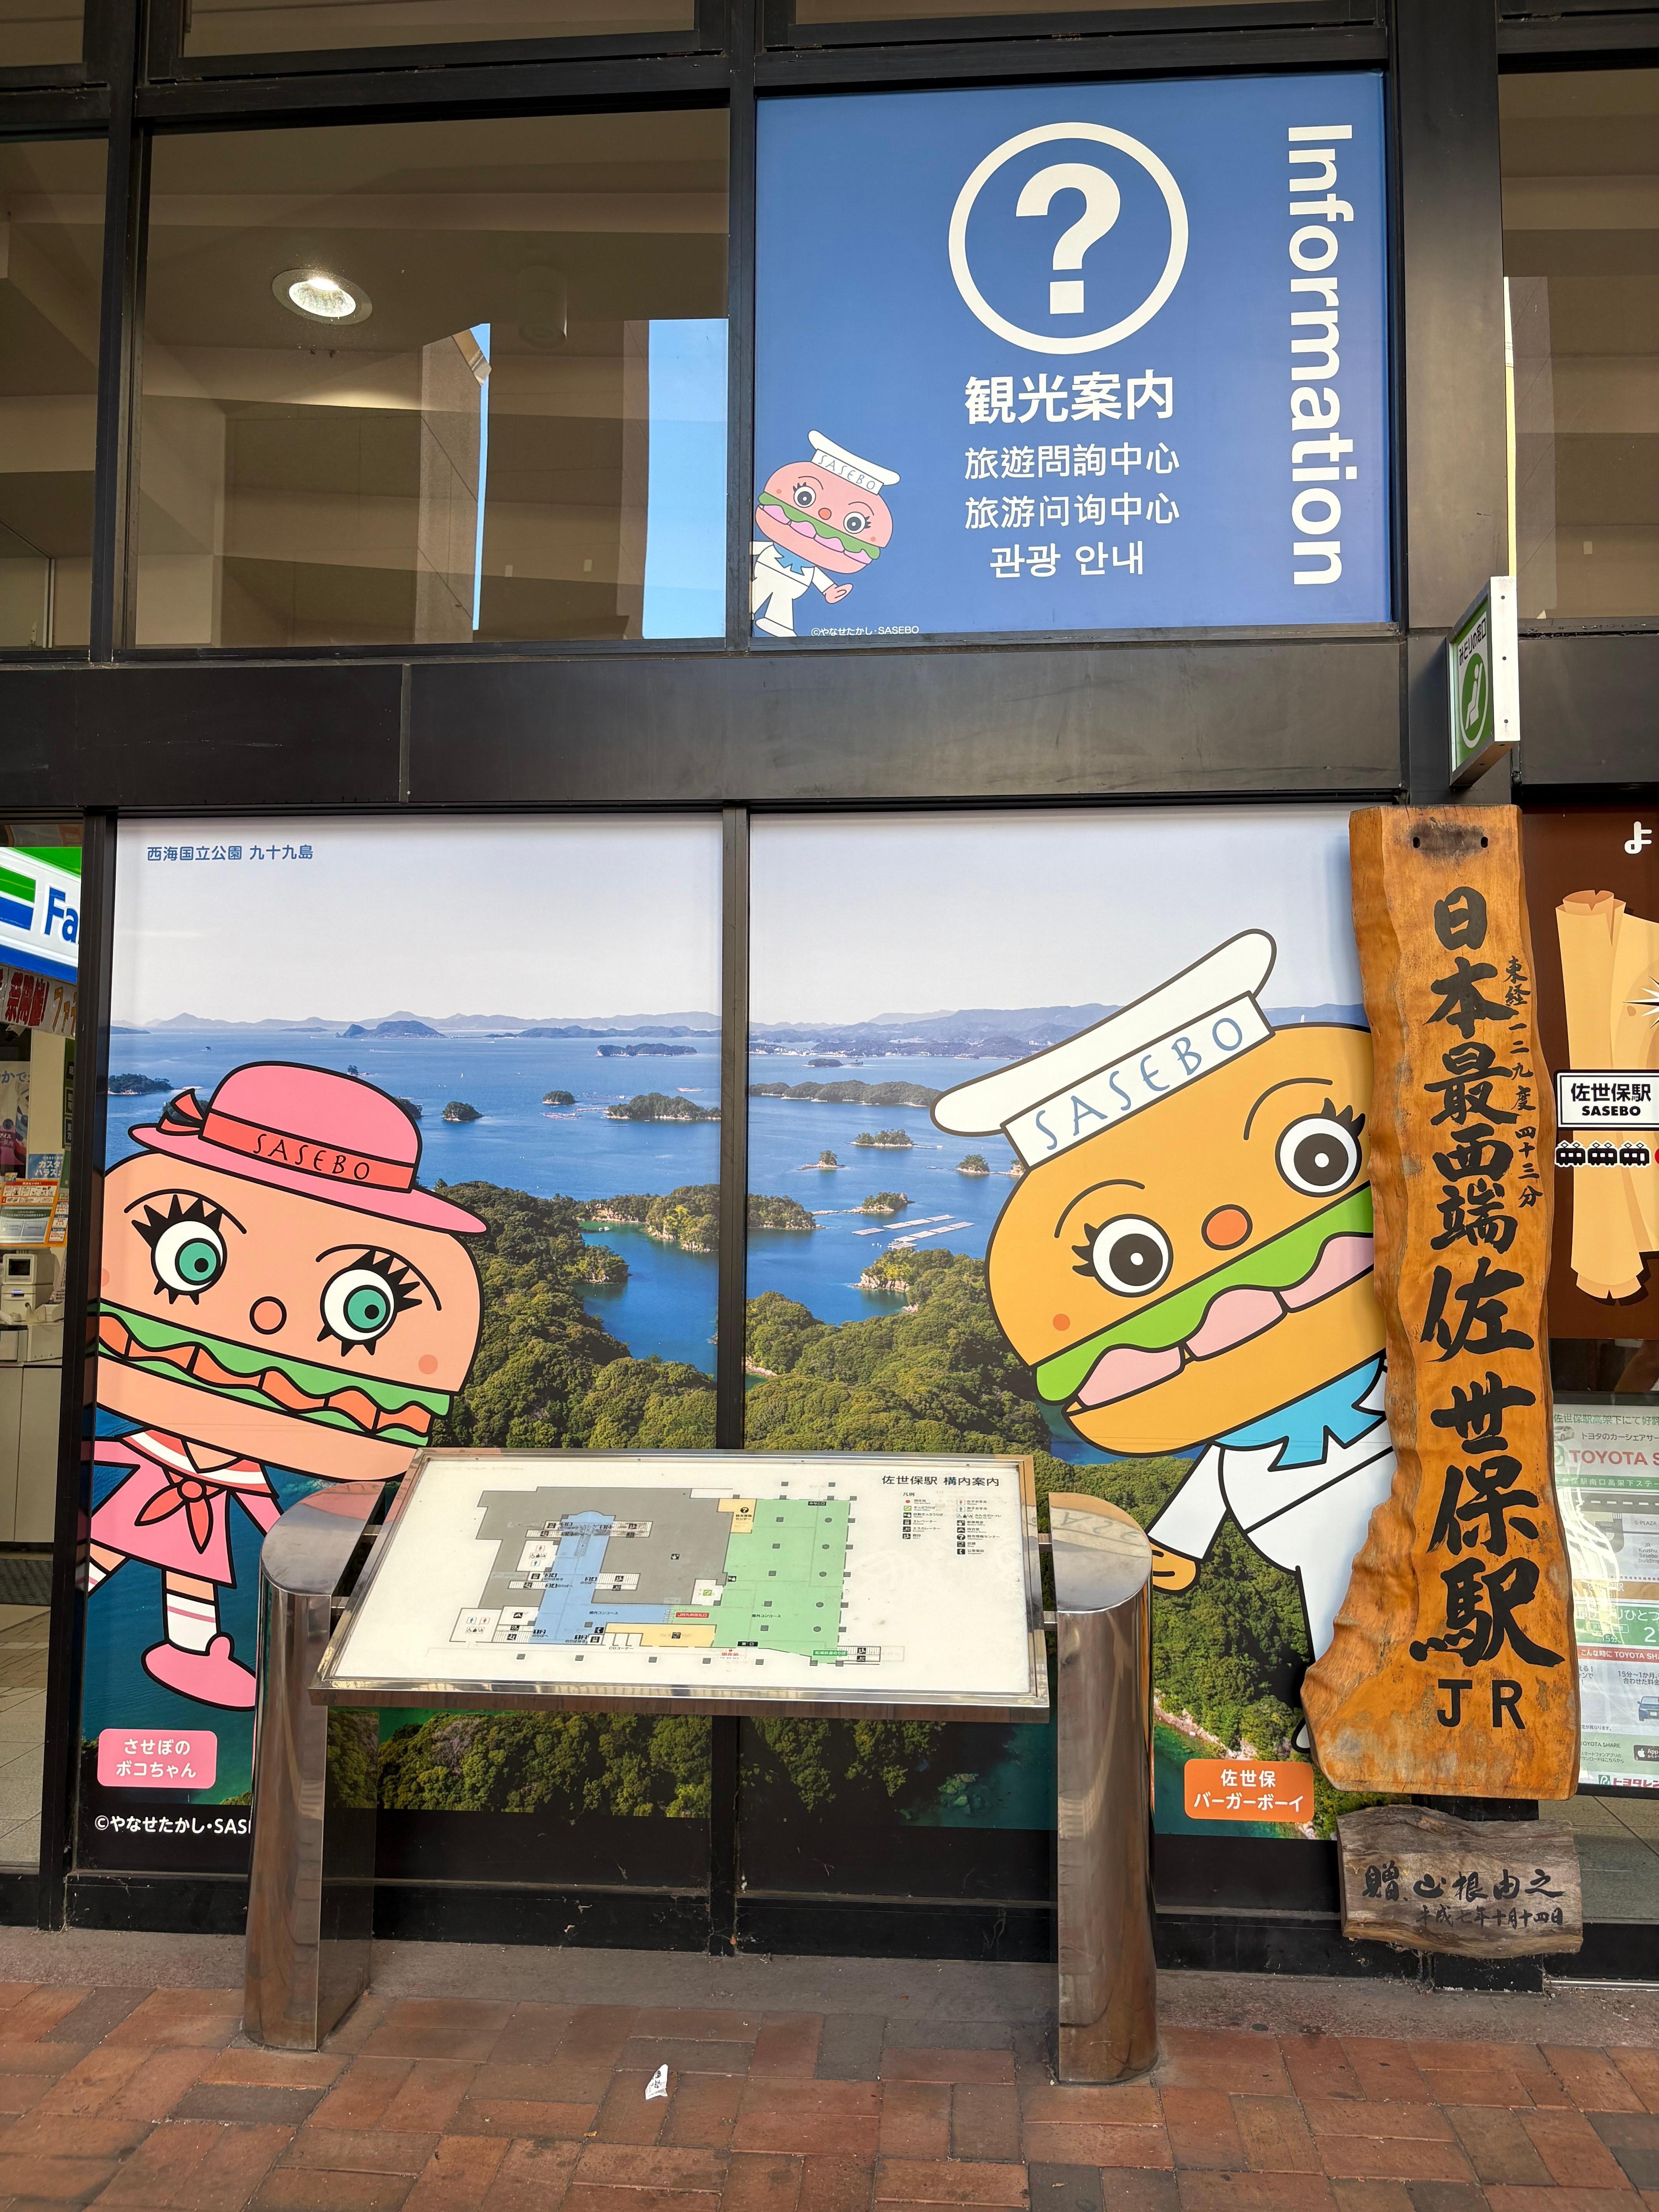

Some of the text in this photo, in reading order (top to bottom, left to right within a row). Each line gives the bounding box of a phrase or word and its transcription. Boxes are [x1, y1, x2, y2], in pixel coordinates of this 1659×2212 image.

[1288, 124, 1357, 585] Information
[965, 369, 1173, 425] 観光案内
[818, 455, 875, 489] SASEBO
[965, 442, 1180, 479] 旅遊問詢中心
[965, 492, 1180, 529] 旅游问询中心
[989, 541, 1143, 578] 관광 안내
[1459, 617, 1486, 666] みどりの窓口
[147, 844, 313, 861] 西海国立公園 九十九島
[1624, 821, 1652, 854] よ
[1036, 1017, 1243, 1150] SASEBO
[1571, 1083, 1651, 1102] 佐世保駅
[1582, 1106, 1641, 1116] SASEBO
[253, 1133, 370, 1180] SASEBO
[1569, 1450, 1648, 1465] TOYOTA
[881, 1475, 1000, 1487] 佐世保駅 構内案内
[1437, 1678, 1526, 1729] JR
[124, 1738, 190, 1755] させぼの
[116, 1760, 197, 1779] ボコちゃん
[1220, 1768, 1276, 1788] 佐世保
[1194, 1791, 1304, 1812] バーガーボーイ
[94, 1815, 251, 1834] ©やなせたかし・SAS
